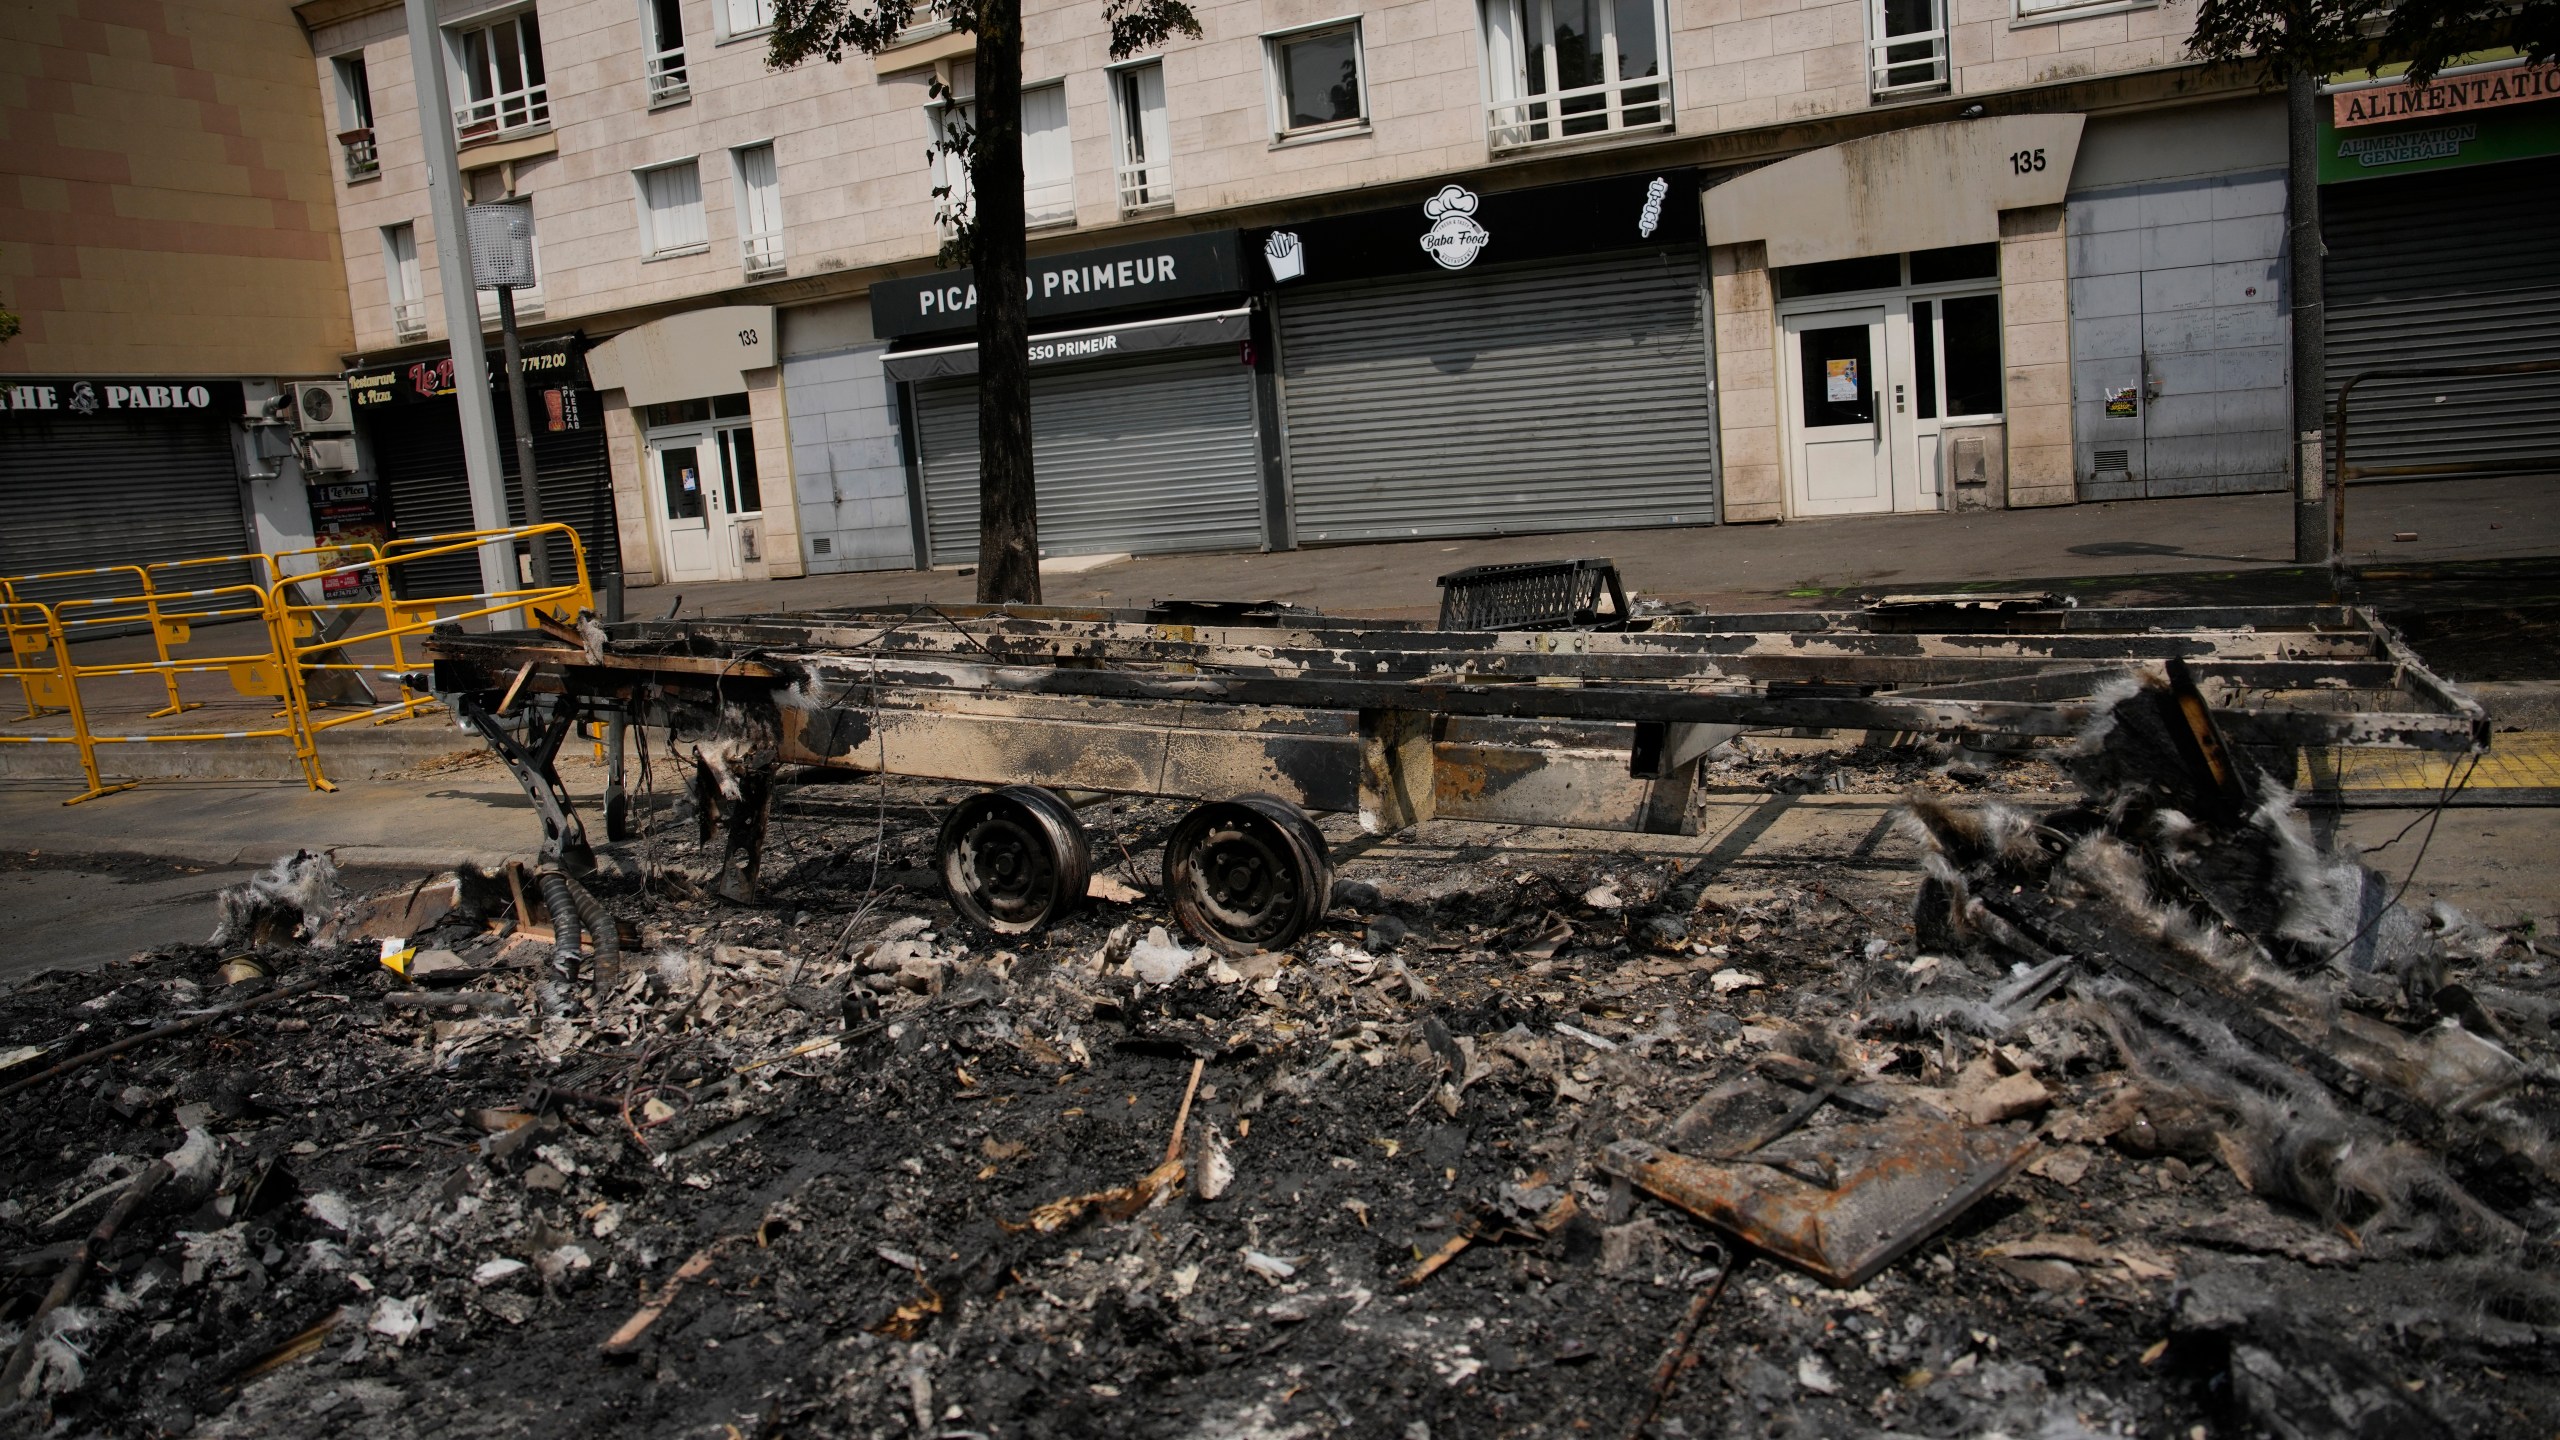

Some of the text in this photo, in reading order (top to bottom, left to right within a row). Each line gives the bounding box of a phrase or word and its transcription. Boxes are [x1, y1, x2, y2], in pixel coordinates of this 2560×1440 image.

[2340, 125, 2476, 154] ALIMENTATION
[2009, 148, 2046, 175] 135
[2360, 141, 2458, 164] GENERALE
[1422, 230, 1487, 249] Baba Food
[1042, 255, 1177, 298] PRIMEUR
[738, 329, 758, 346] 133
[1057, 335, 1118, 357] PRIMEUR
[348, 371, 397, 390] Restaurant
[408, 362, 439, 397] Le
[104, 385, 210, 408] PABLO
[357, 389, 393, 405] & Pizza
[562, 390, 574, 429] PIZZA
[569, 390, 580, 429] KEBAB
